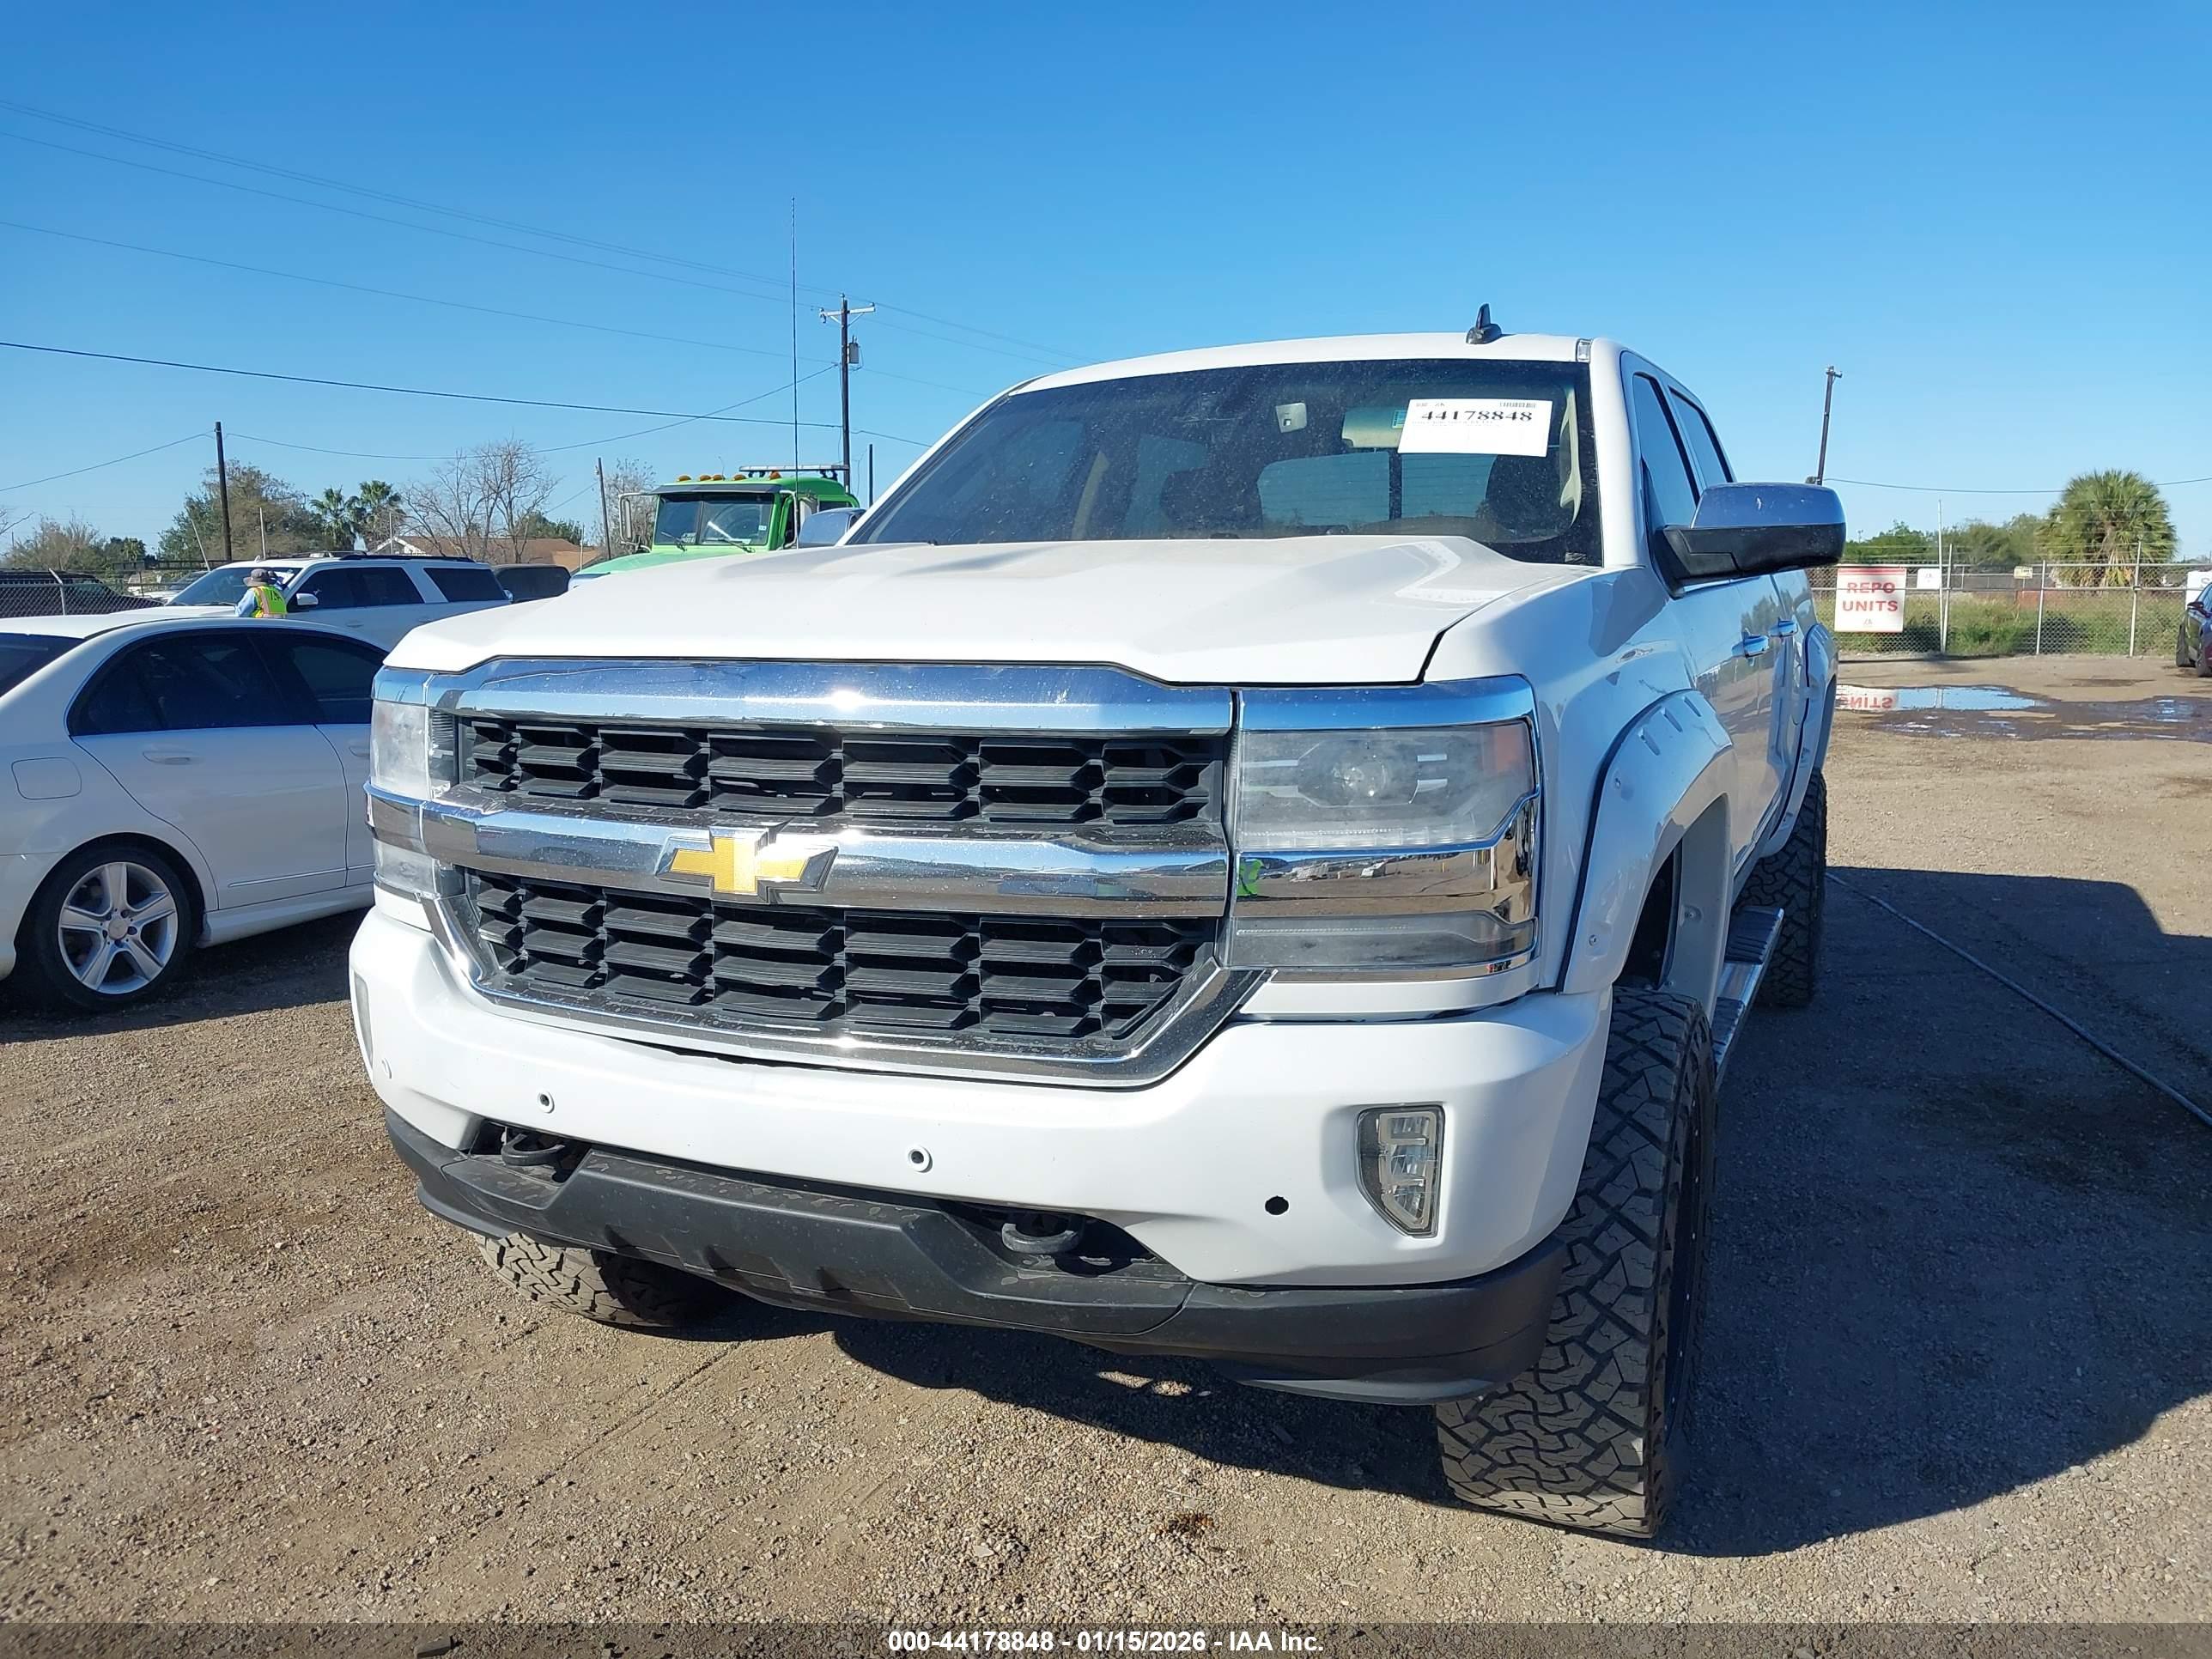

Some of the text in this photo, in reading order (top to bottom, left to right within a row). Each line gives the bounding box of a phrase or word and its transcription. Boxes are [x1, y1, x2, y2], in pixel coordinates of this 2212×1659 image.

[1421, 410, 1532, 421] 44178848
[1846, 582, 1895, 593] REPO
[1842, 600, 1898, 611] UNITS
